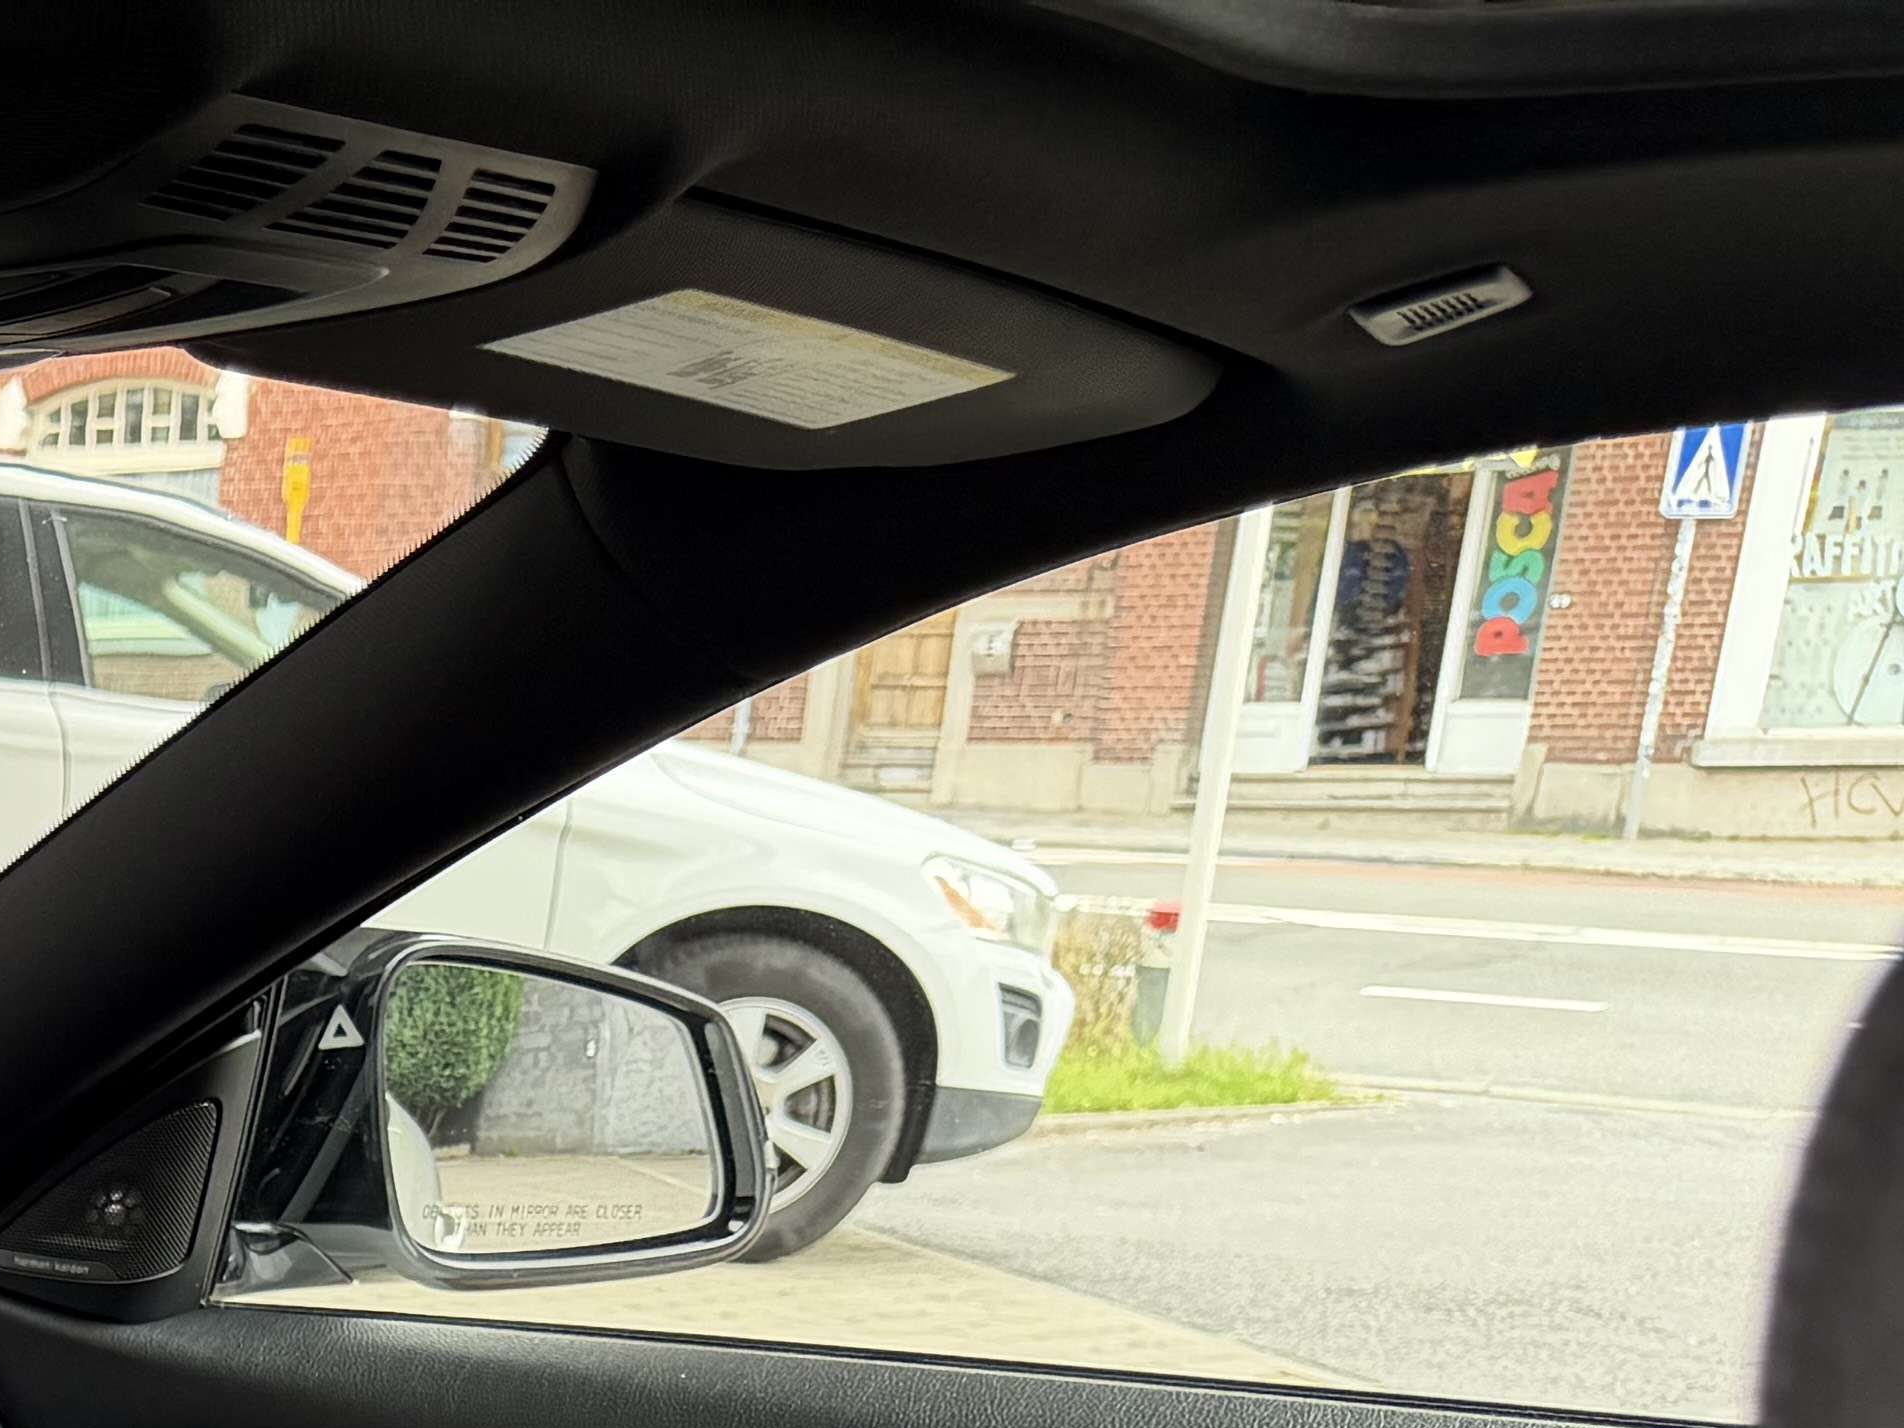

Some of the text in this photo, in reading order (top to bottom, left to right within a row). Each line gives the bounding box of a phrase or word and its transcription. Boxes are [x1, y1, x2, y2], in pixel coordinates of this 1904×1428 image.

[1474, 470, 1559, 656] POSCA
[489, 1204, 504, 1219] IN
[511, 1204, 559, 1219] MIRROR
[564, 1204, 589, 1219] ARE
[596, 1204, 643, 1219] CLOSER
[495, 1222, 527, 1237] THEY
[532, 1222, 582, 1237] APPEAR
